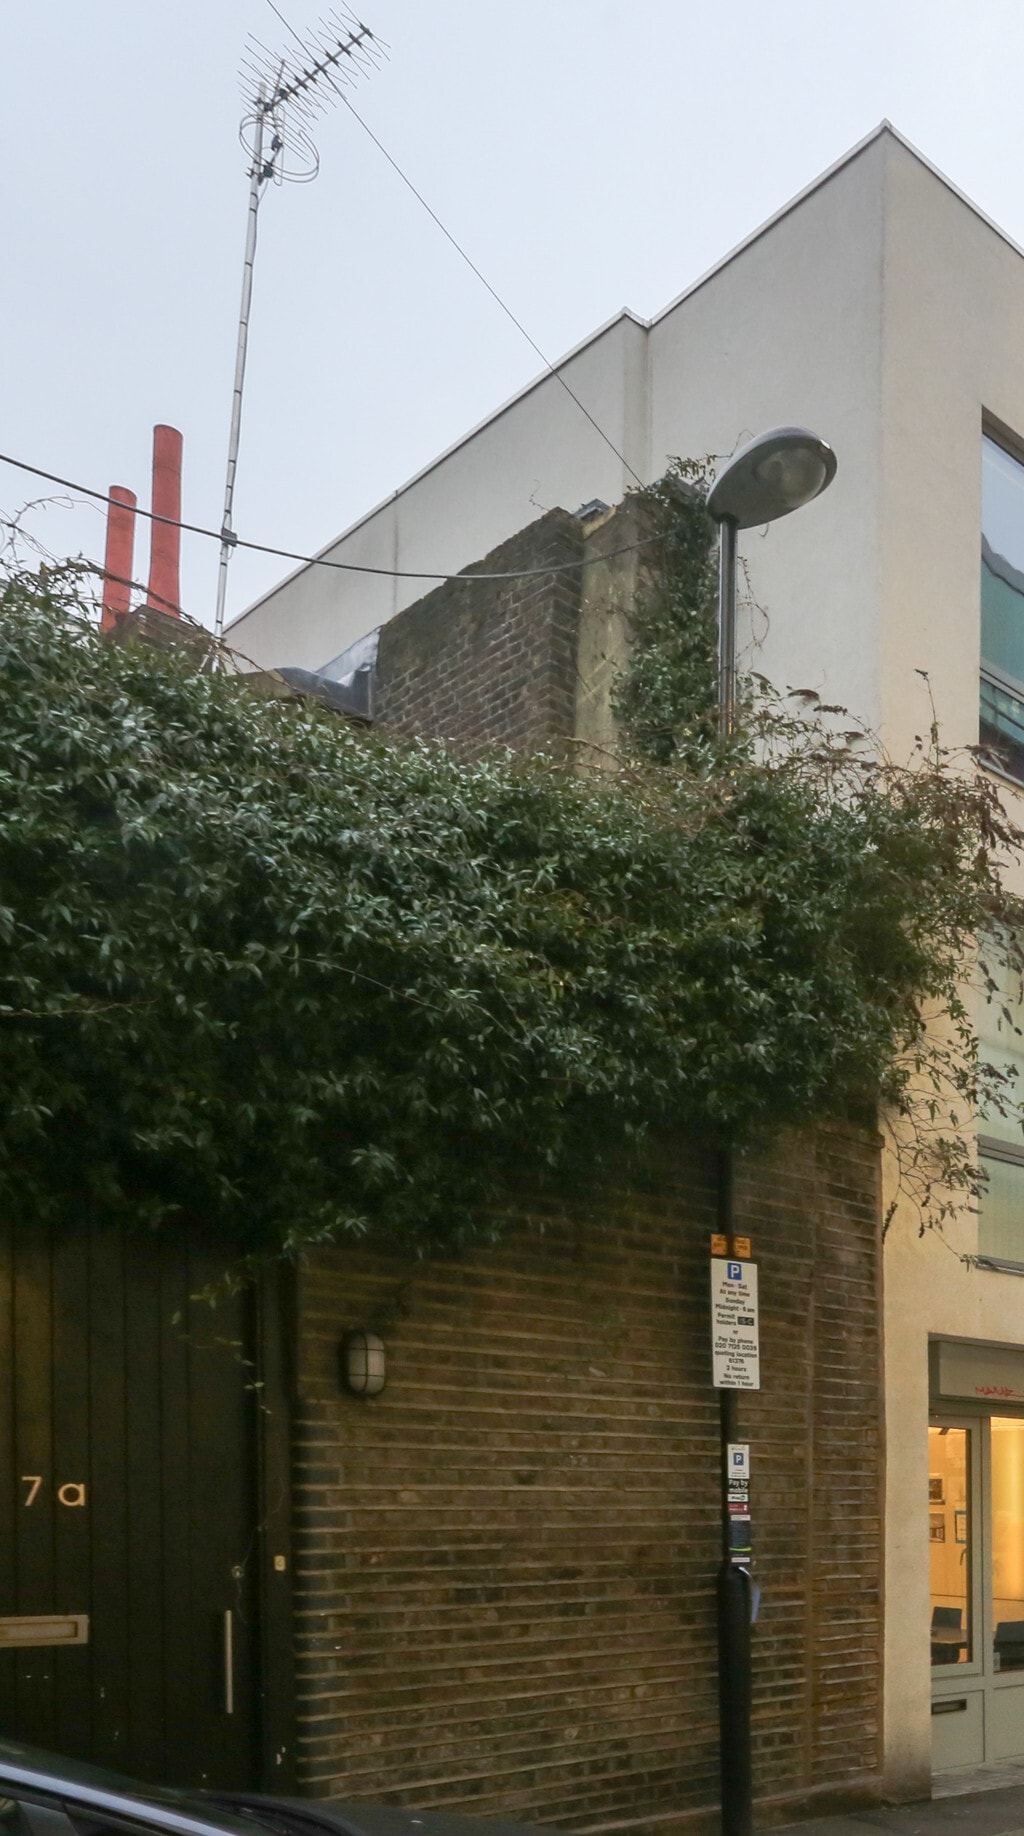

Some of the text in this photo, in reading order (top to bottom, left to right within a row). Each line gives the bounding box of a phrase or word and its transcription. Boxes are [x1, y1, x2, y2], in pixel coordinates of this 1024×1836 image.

[730, 1264, 740, 1278] P
[725, 1297, 745, 1305] Sunday
[736, 1455, 742, 1464] P
[728, 1479, 749, 1488] Pay by
